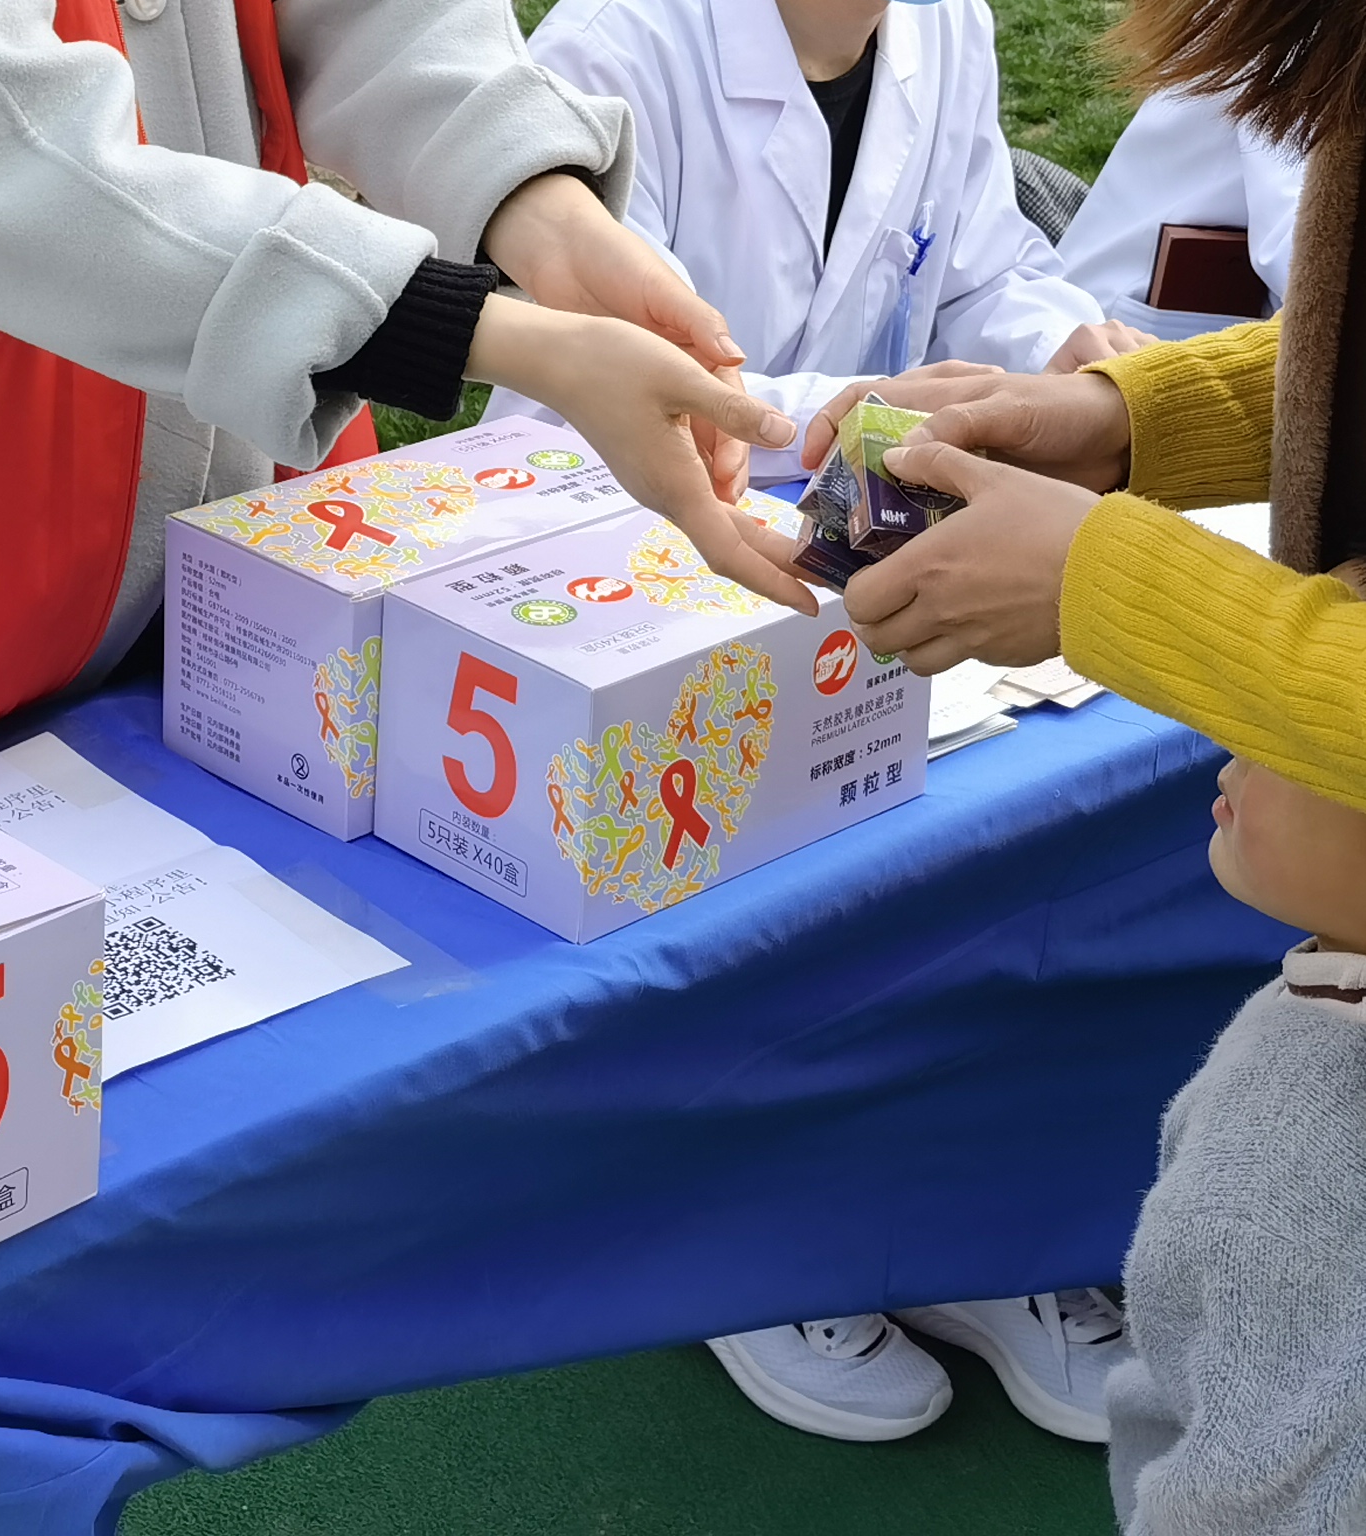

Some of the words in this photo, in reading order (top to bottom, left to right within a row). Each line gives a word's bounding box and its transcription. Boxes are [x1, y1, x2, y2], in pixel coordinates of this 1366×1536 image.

[442, 651, 519, 819] 5
[811, 724, 847, 748] PREMIUM
[847, 716, 872, 734] LATEX
[871, 701, 904, 723] CONDOM
[839, 759, 903, 808] 颗粒型
[427, 820, 469, 859] 5只装
[472, 843, 520, 888] X40盒
